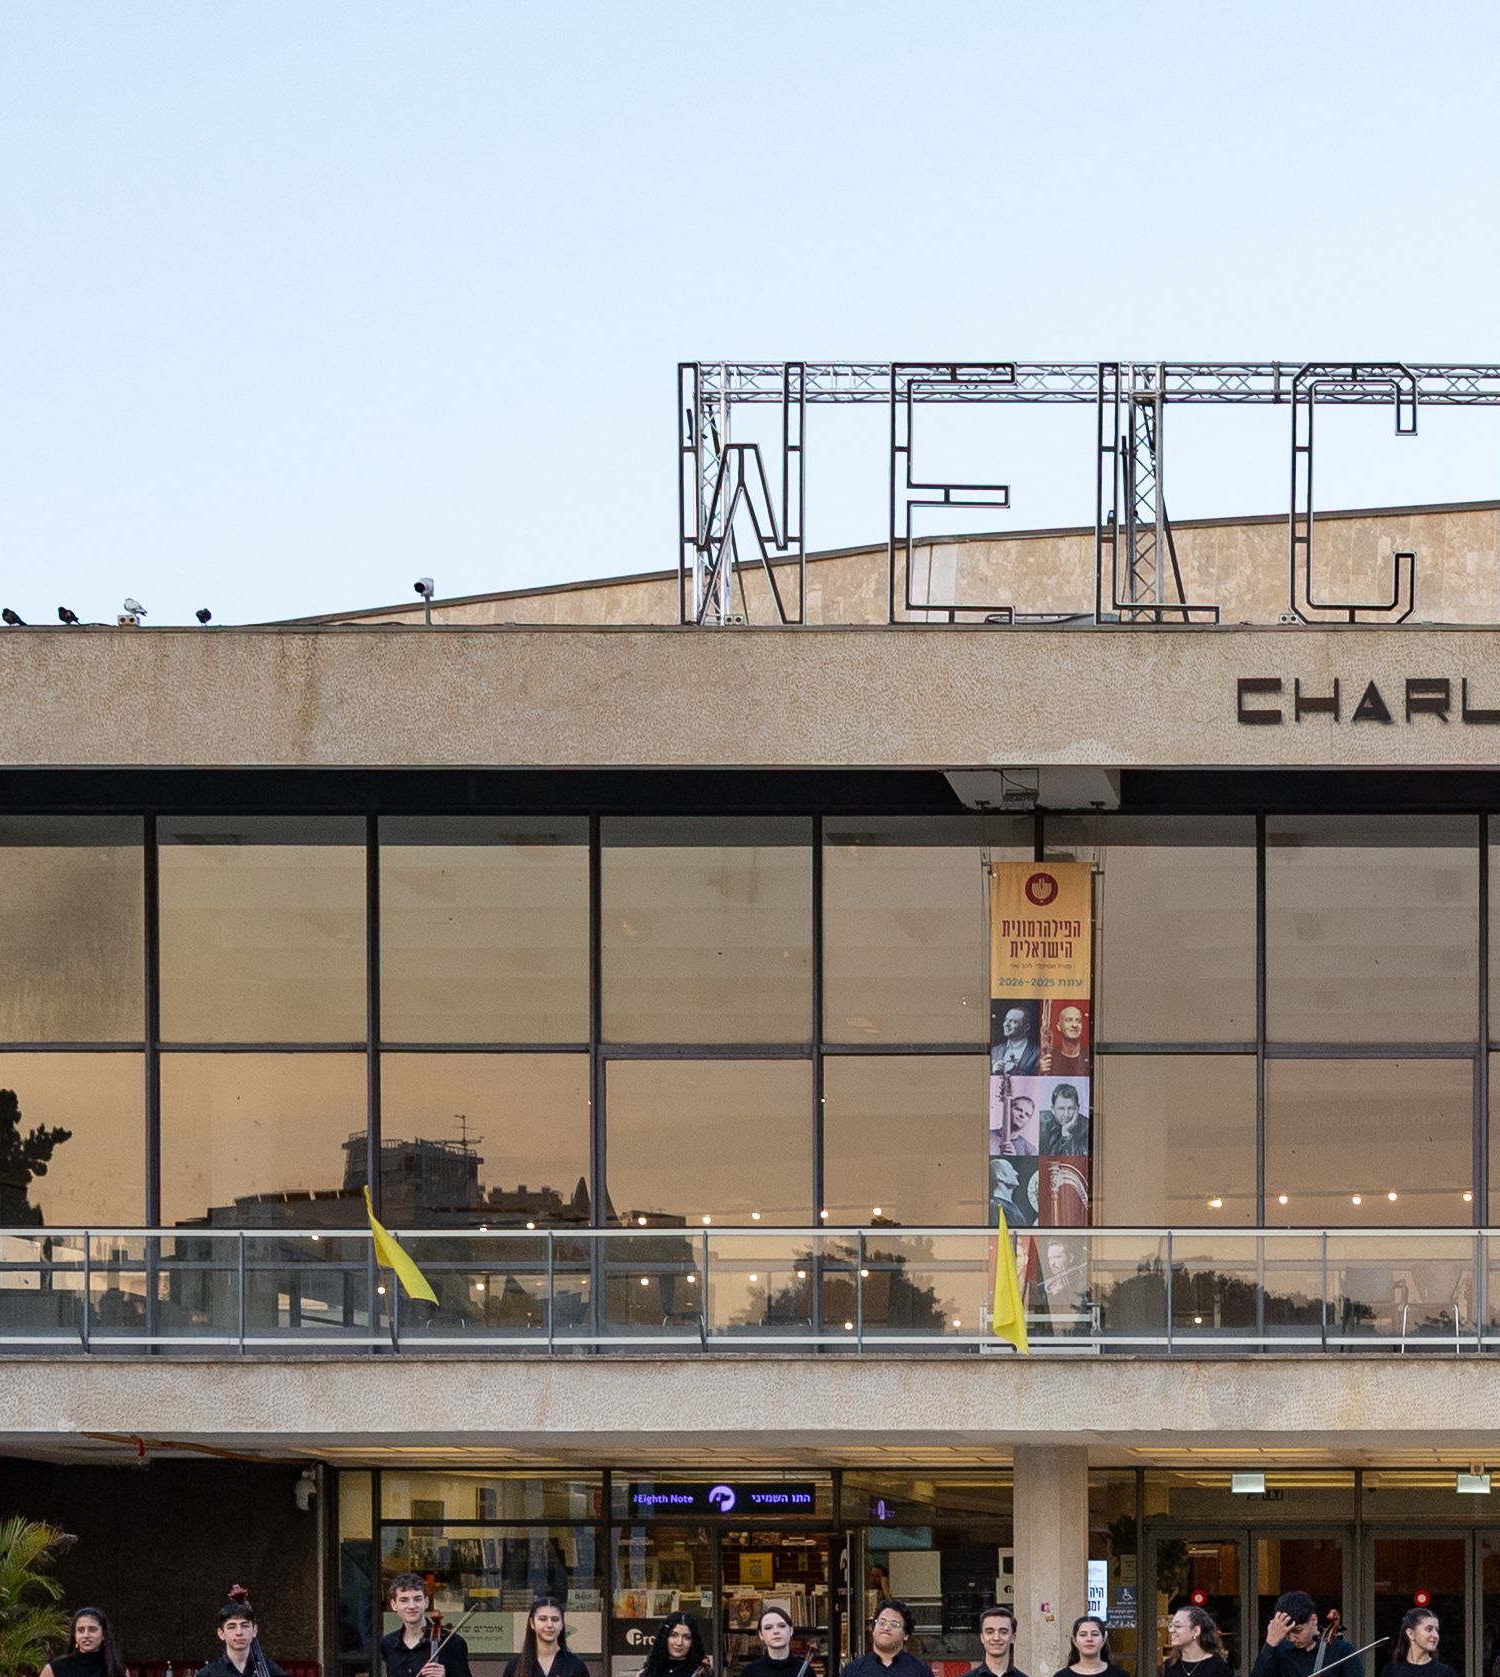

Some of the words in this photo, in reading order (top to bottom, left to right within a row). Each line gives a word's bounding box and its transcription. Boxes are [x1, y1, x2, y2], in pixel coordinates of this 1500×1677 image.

[1002, 920, 1081, 938] הפילהרמונית
[1010, 940, 1073, 959] הישראלית
[1058, 978, 1083, 987] עונת
[638, 1494, 669, 1505] Eighth
[671, 1494, 694, 1504] Note
[752, 1494, 788, 1504] השמיני
[792, 1494, 811, 1503] התו
